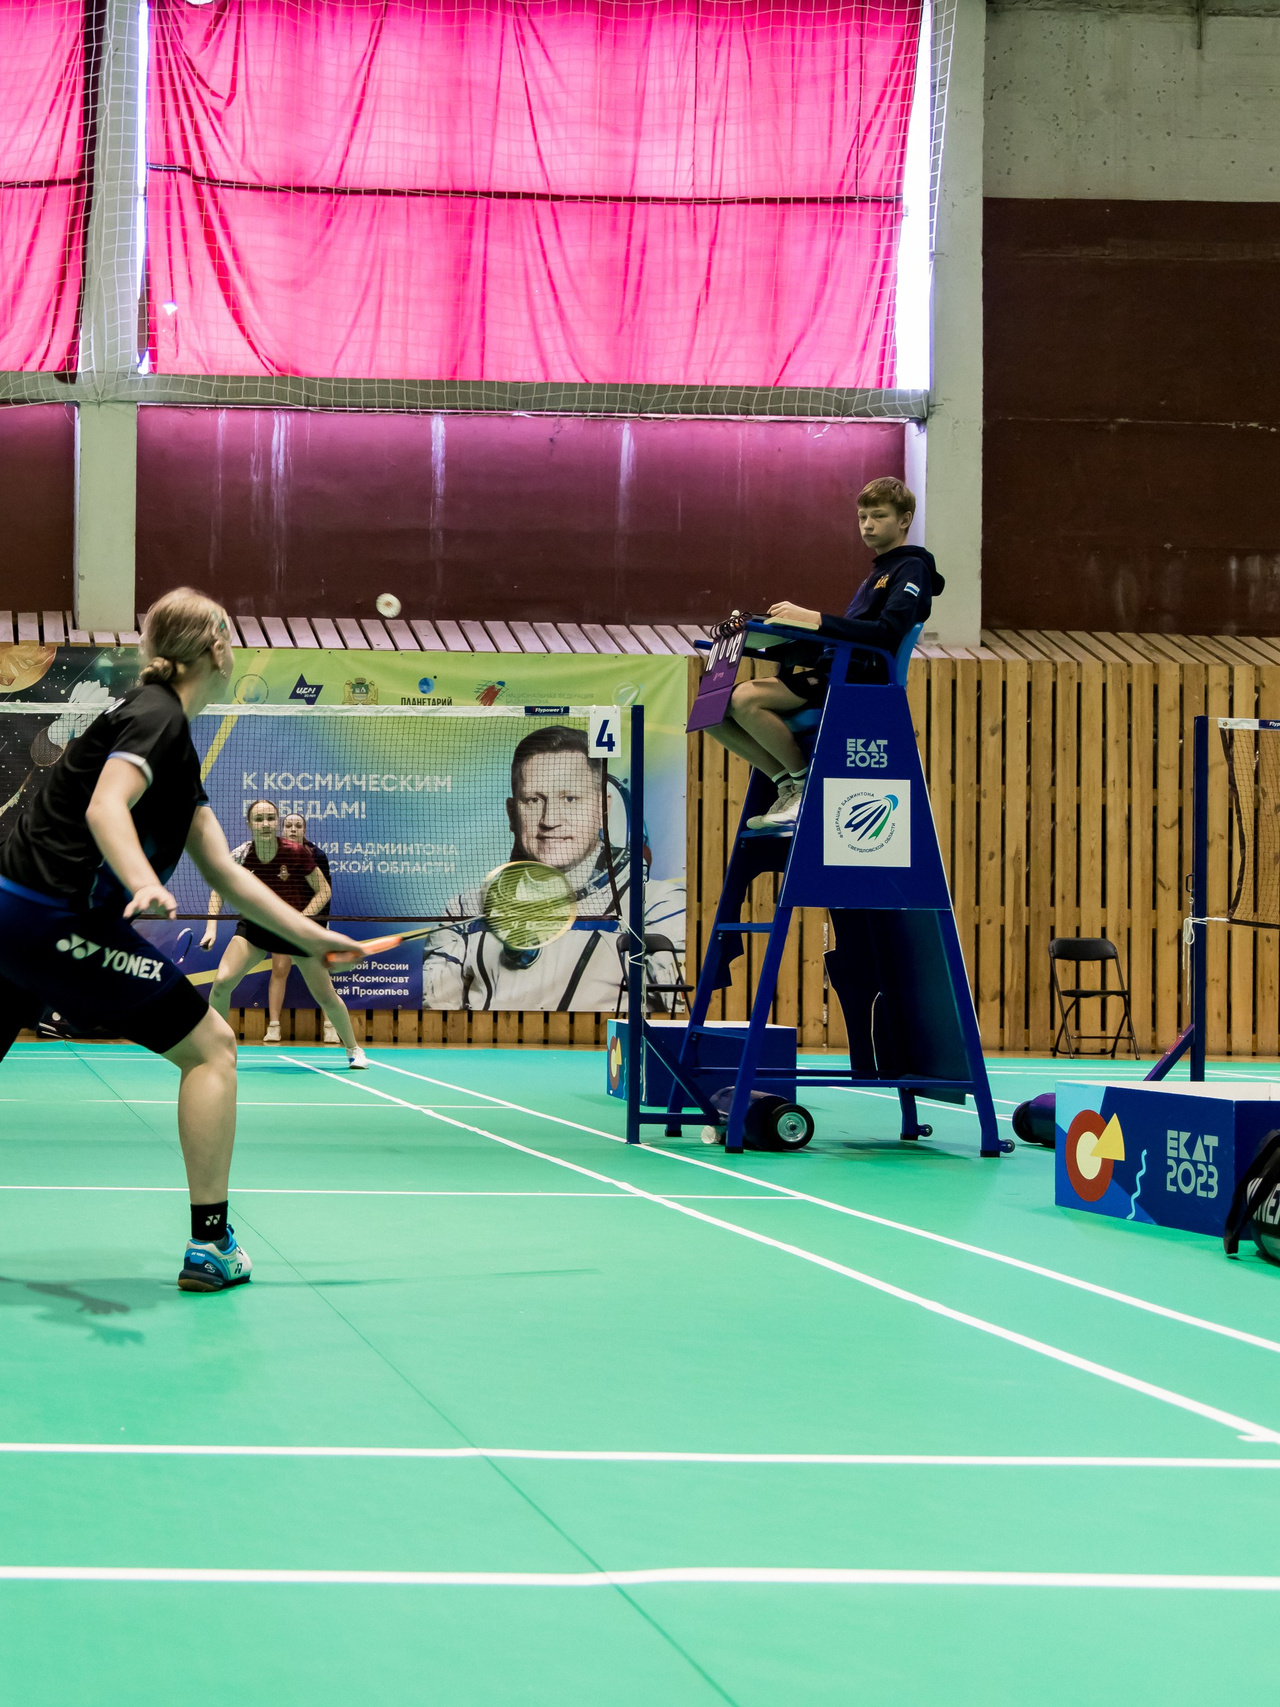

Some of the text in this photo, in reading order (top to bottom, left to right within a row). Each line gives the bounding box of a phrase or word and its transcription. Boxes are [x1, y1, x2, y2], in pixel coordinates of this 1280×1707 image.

[400, 697, 453, 706] ПЛАНЕТАРИЙ
[595, 719, 616, 752] 4
[846, 738, 888, 753] EKAT
[846, 752, 888, 769] 2023
[242, 771, 452, 793] К КОСМИЧЕСКИМ
[834, 791, 875, 839] ФЕДЕРАЦИЯ БАДМИНТОНА
[847, 822, 896, 854] СВЕРДЛОВСКОЙ ОБЛАСТИ
[343, 842, 460, 857] БАДМИНТОНА
[377, 859, 456, 874] ОБЛАСТИ
[101, 947, 164, 982] YONEX
[371, 961, 409, 971] России
[351, 986, 410, 998] Прокопьев
[1166, 1129, 1219, 1163] EKAT
[1166, 1158, 1219, 1199] 2023
